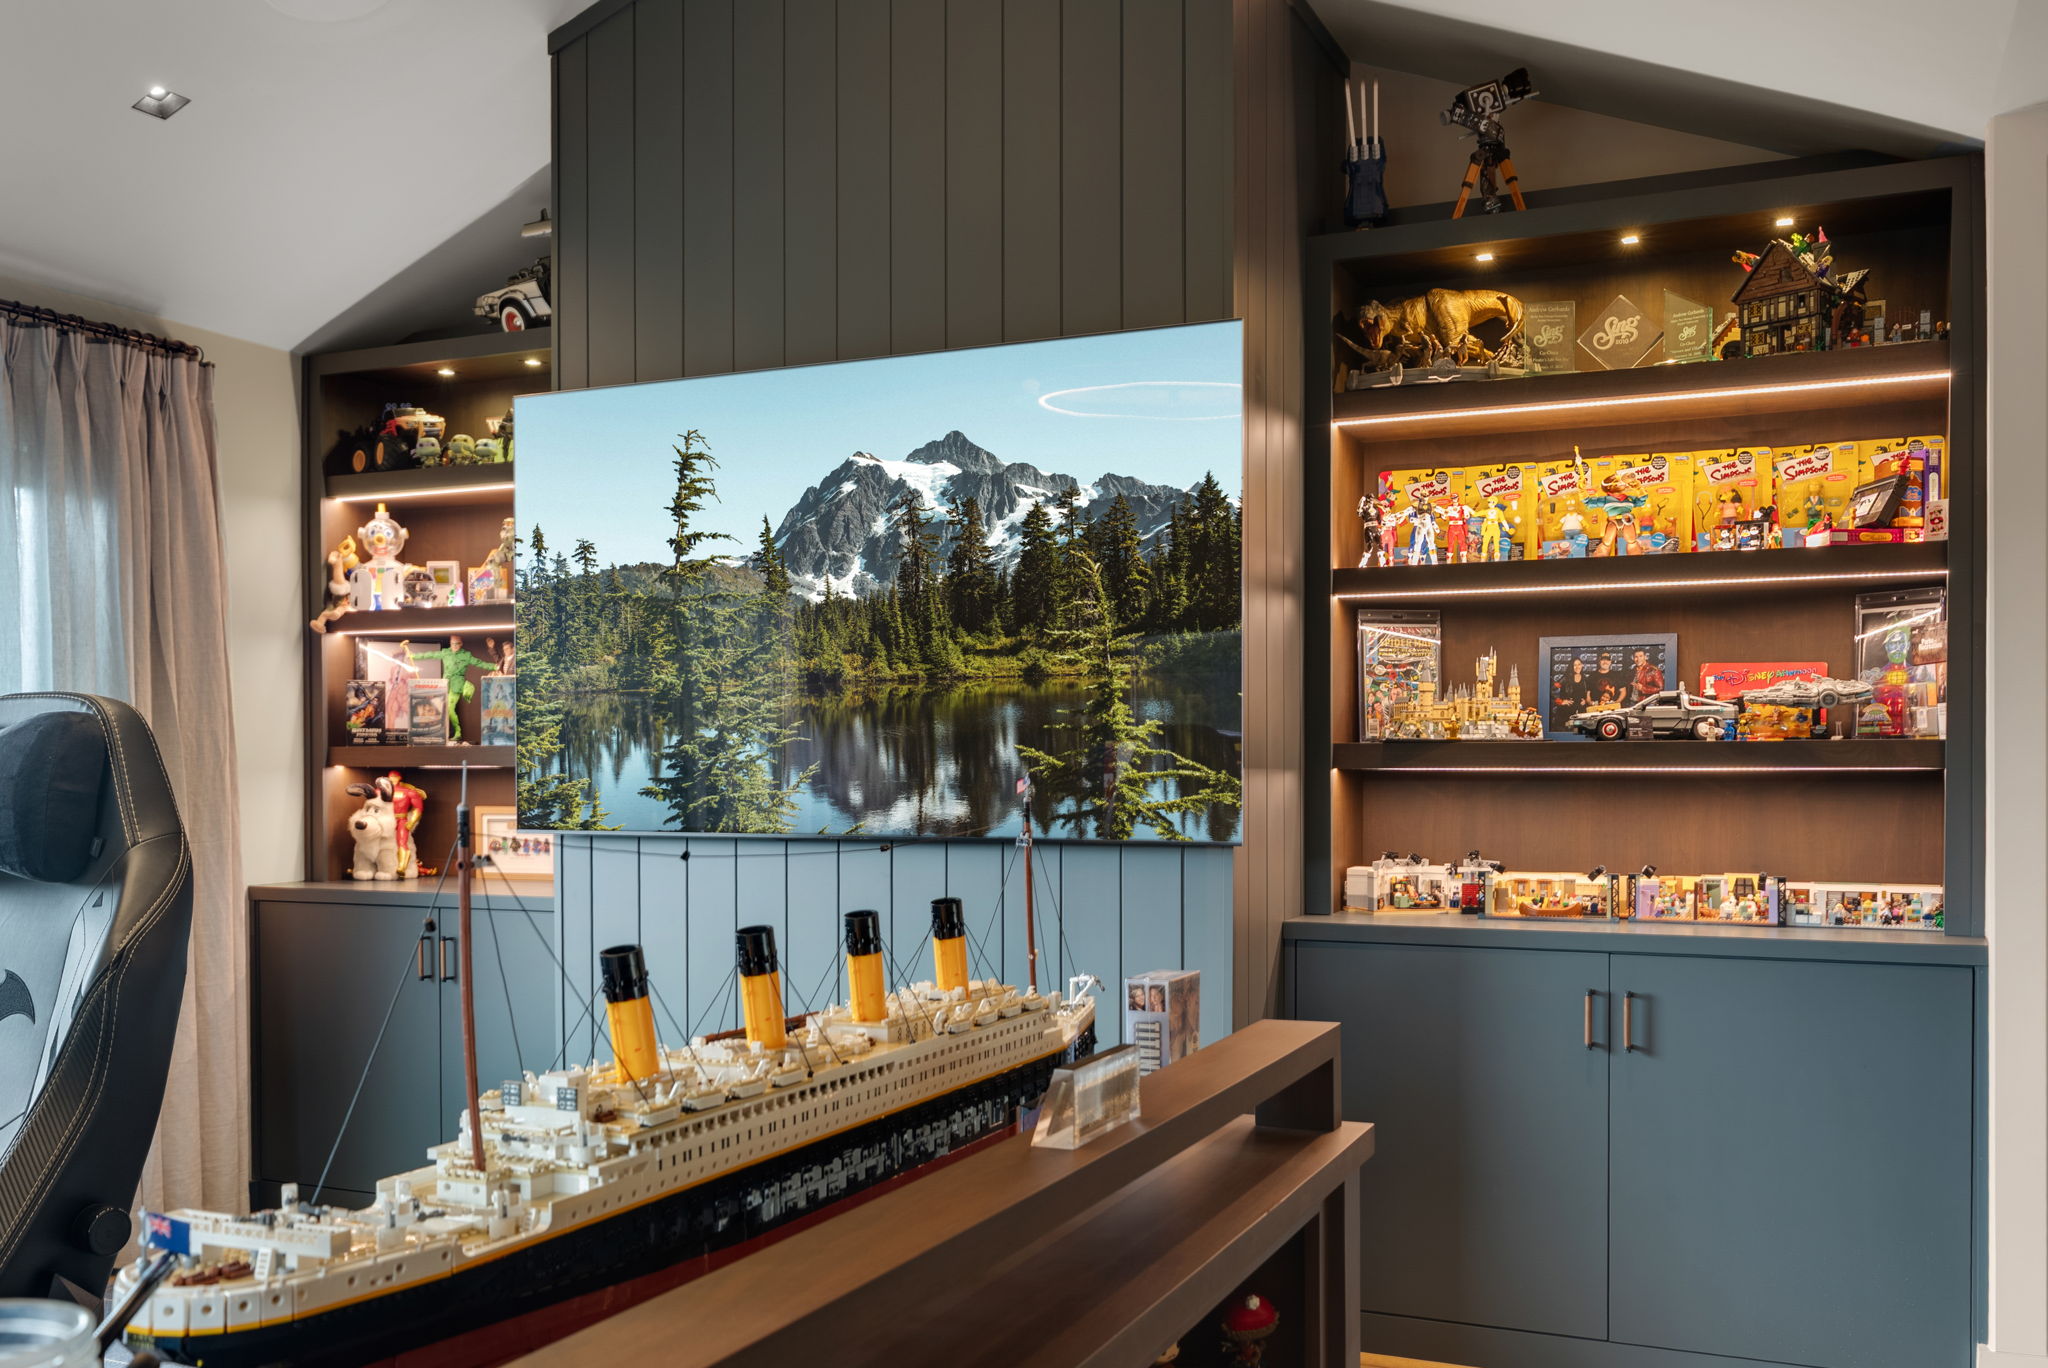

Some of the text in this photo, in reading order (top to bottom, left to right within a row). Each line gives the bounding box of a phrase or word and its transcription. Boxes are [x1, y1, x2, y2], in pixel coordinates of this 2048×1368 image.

[1721, 461, 1738, 471] THE
[1796, 457, 1814, 466] THE
[1635, 466, 1651, 475] THE
[1492, 476, 1506, 485] THE
[1558, 472, 1575, 482] THE
[1421, 482, 1435, 490] THE
[1481, 481, 1520, 497] SIMPSONS
[1547, 478, 1582, 495] SIMPS
[1136, 1023, 1161, 1076] TITAN
